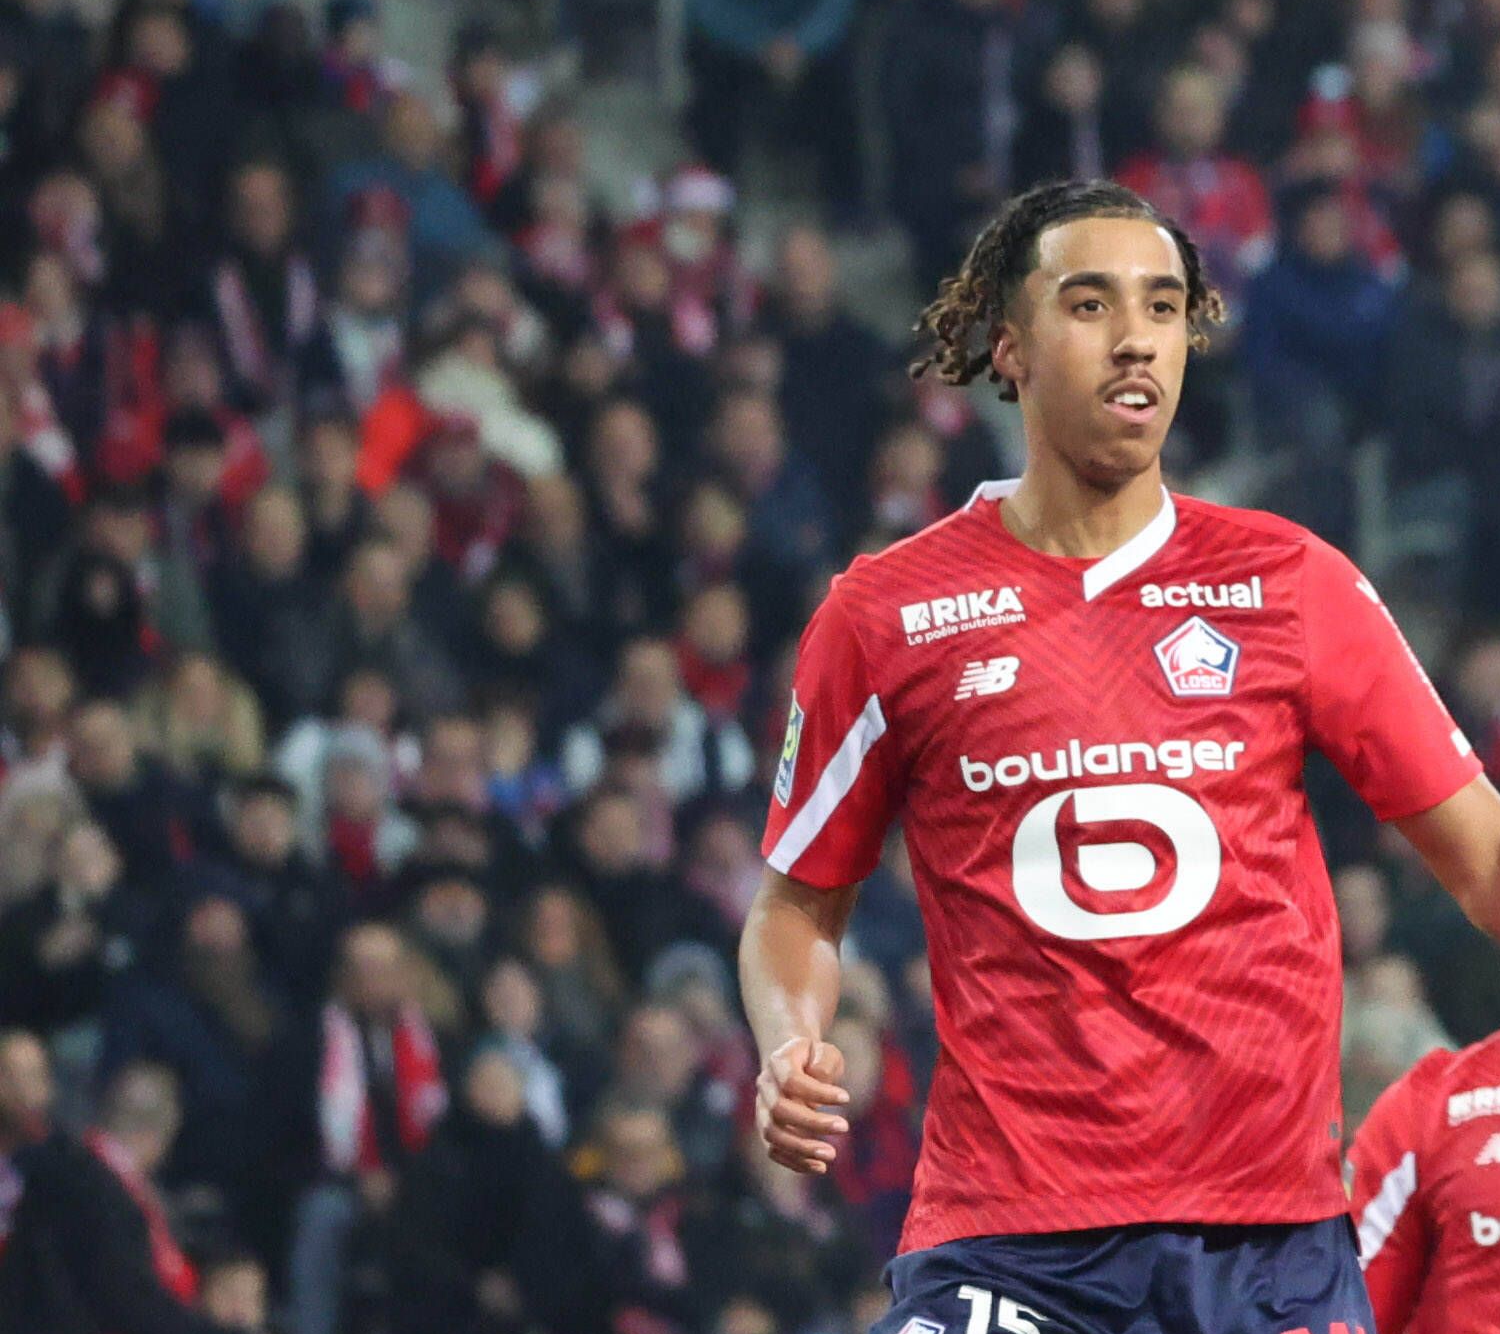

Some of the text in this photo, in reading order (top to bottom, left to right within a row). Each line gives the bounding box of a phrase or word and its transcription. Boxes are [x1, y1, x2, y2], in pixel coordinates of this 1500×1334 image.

[931, 586, 1024, 627] RIKA
[1139, 575, 1263, 609] actual
[906, 634, 925, 646] Le
[960, 612, 1026, 632] autrichien
[1179, 673, 1222, 688] LOSC
[960, 739, 1245, 793] boulanger
